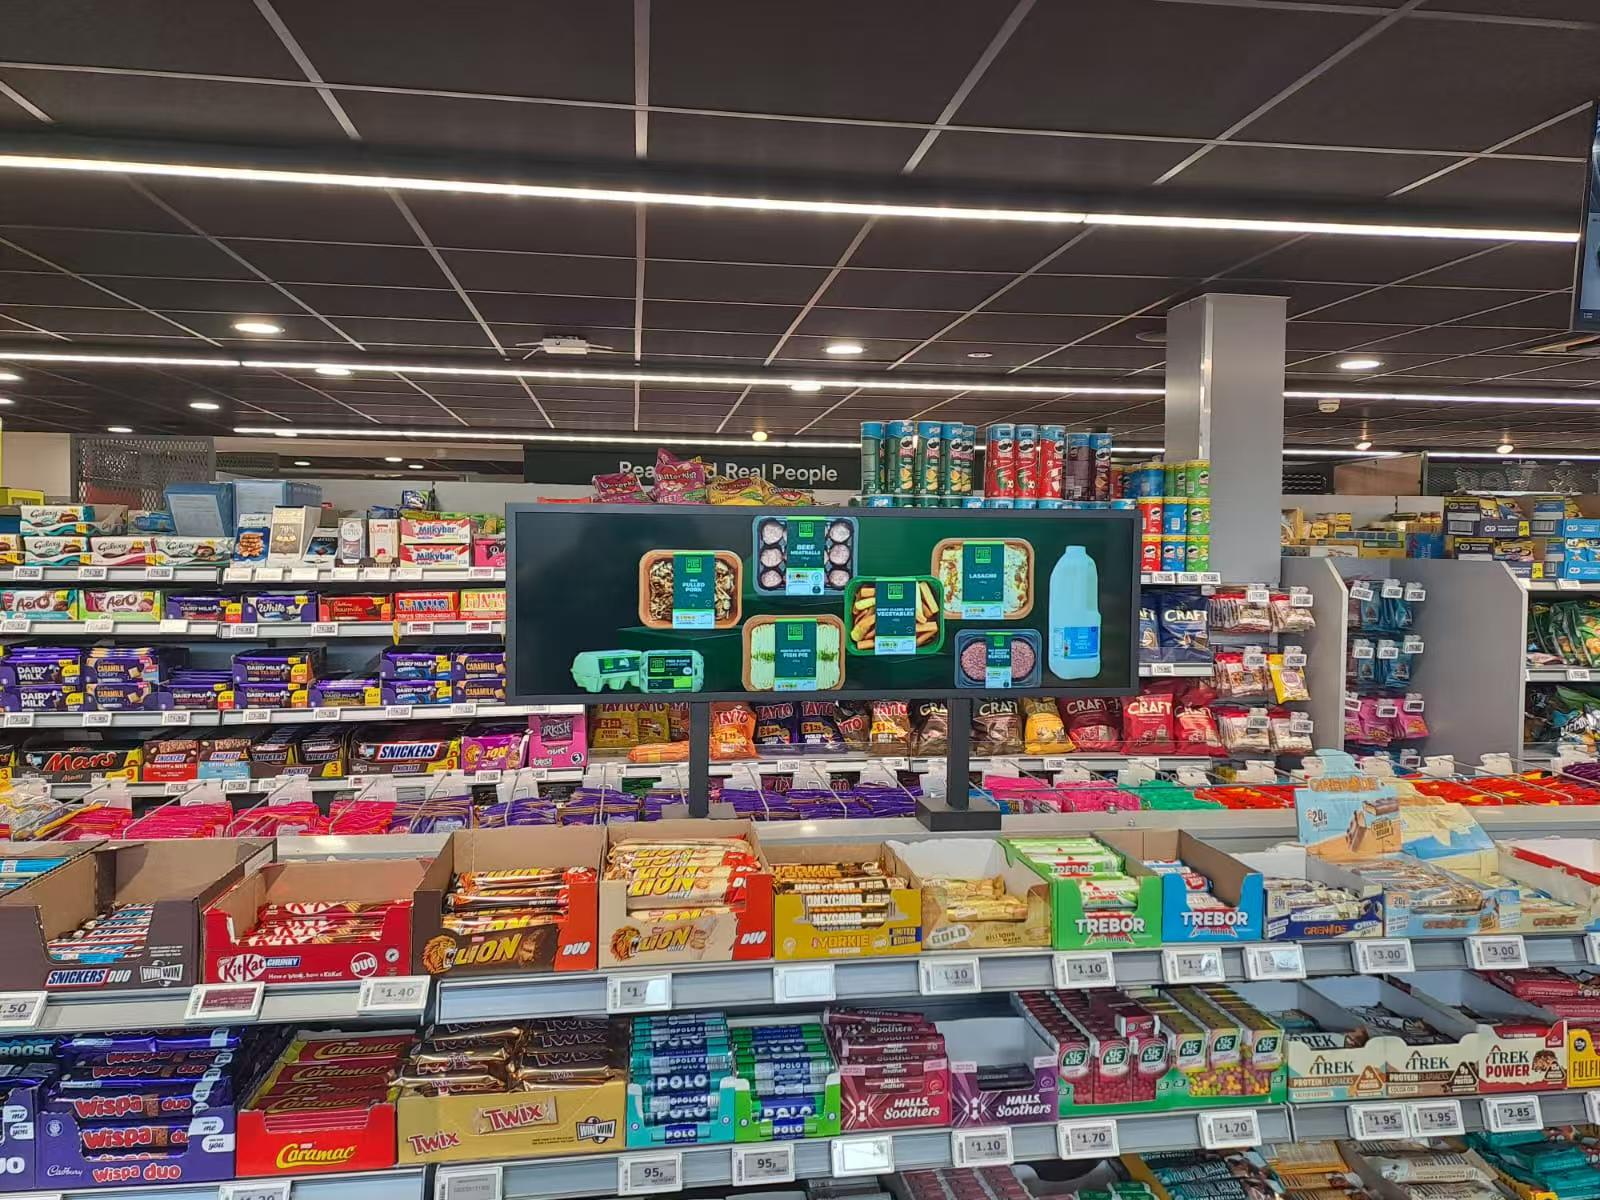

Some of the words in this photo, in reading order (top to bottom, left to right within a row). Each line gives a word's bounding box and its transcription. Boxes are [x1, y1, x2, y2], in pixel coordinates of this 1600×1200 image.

[619, 461, 656, 478] Rea
[726, 463, 766, 480] Real
[772, 464, 838, 485] People
[30, 509, 58, 518] Galaxy
[418, 525, 456, 536] Milkybar
[34, 540, 61, 549] Galaxy
[97, 542, 127, 552] Galaxy
[167, 541, 195, 551] Galaxy
[416, 552, 454, 563] Milkybar
[1164, 609, 1208, 622] CRAFT
[17, 666, 48, 674] DAIRY
[466, 663, 495, 671] CARAMILK
[20, 692, 51, 700] DAIRY
[466, 688, 494, 696] CARAMILK
[22, 699, 46, 707] MILK
[801, 701, 835, 716] TAYTO
[1127, 701, 1172, 715] CRAFT
[716, 709, 749, 725] TAYTO
[756, 703, 794, 720] TAYTO
[380, 745, 438, 758] SNICKERS
[43, 752, 117, 771] Mars
[330, 762, 339, 771] 3
[447, 759, 454, 769] 9
[127, 768, 134, 779] 9
[632, 877, 696, 896] LION
[1180, 911, 1248, 927] TREBOR
[1075, 918, 1145, 933] TREBOR
[640, 926, 693, 952] LION
[740, 931, 767, 944] DUO
[931, 927, 967, 944] GOLD
[818, 935, 870, 948] YORKIE
[454, 933, 522, 965] LION
[562, 941, 590, 955] DUO
[1486, 946, 1514, 956] £3.00
[1373, 950, 1401, 961] £3.00
[267, 958, 298, 966] CHUNKY
[352, 957, 375, 973] DUO
[162, 965, 182, 978] WIN
[224, 955, 265, 982] KitKat
[1073, 963, 1101, 974] £1.10
[48, 969, 106, 985] SNICKERS
[108, 969, 132, 983] DUO
[871, 1025, 912, 1034] Soothers
[1186, 1041, 1198, 1049] tic
[1220, 1036, 1233, 1044] tic
[1261, 1037, 1275, 1045] tic
[314, 1041, 404, 1059] Caramac
[1146, 1047, 1161, 1055] tic
[1216, 1042, 1232, 1051] tac
[1258, 1043, 1273, 1051] tac
[1069, 1050, 1085, 1059] tic
[1109, 1049, 1124, 1057] tic
[1143, 1053, 1160, 1061] tac
[1488, 1050, 1530, 1064] TREK
[1065, 1056, 1084, 1065] tac
[1105, 1055, 1122, 1064] tac
[1408, 1057, 1449, 1070] TREK
[292, 1065, 387, 1081] Caramac
[1312, 1061, 1354, 1074] TREK
[1485, 1064, 1530, 1078] POWER
[657, 1074, 707, 1089] POLO
[1293, 1078, 1322, 1087] PROTEIN
[1389, 1072, 1418, 1082] PROTEIN
[265, 1096, 369, 1114] Caramac
[676, 1096, 698, 1104] POLO
[894, 1096, 929, 1107] HALLS
[1006, 1094, 1041, 1105] HALLS
[75, 1095, 143, 1118] Wispa
[162, 1098, 191, 1110] duo
[996, 1103, 1051, 1117] Soothers
[1503, 1107, 1530, 1117] £2.85
[483, 1103, 545, 1131] Twix
[884, 1106, 940, 1120] Soothers
[1424, 1111, 1451, 1122] £1.95
[1369, 1115, 1397, 1126] £1.95
[203, 1123, 217, 1131] me
[579, 1124, 596, 1137] WIN
[597, 1121, 615, 1136] WIN
[774, 1125, 803, 1134] POLO
[1219, 1122, 1247, 1133] £1.70
[83, 1127, 152, 1149] Wispa
[666, 1129, 697, 1138] POLO
[1077, 1133, 1106, 1144] £1.70
[208, 1141, 224, 1150] you
[408, 1131, 460, 1154] Twix
[971, 1140, 1001, 1152] £1.10
[276, 1143, 357, 1168] Caramac
[47, 1165, 83, 1177] Cadbury
[92, 1166, 140, 1183] Wispa
[143, 1164, 181, 1180] duo
